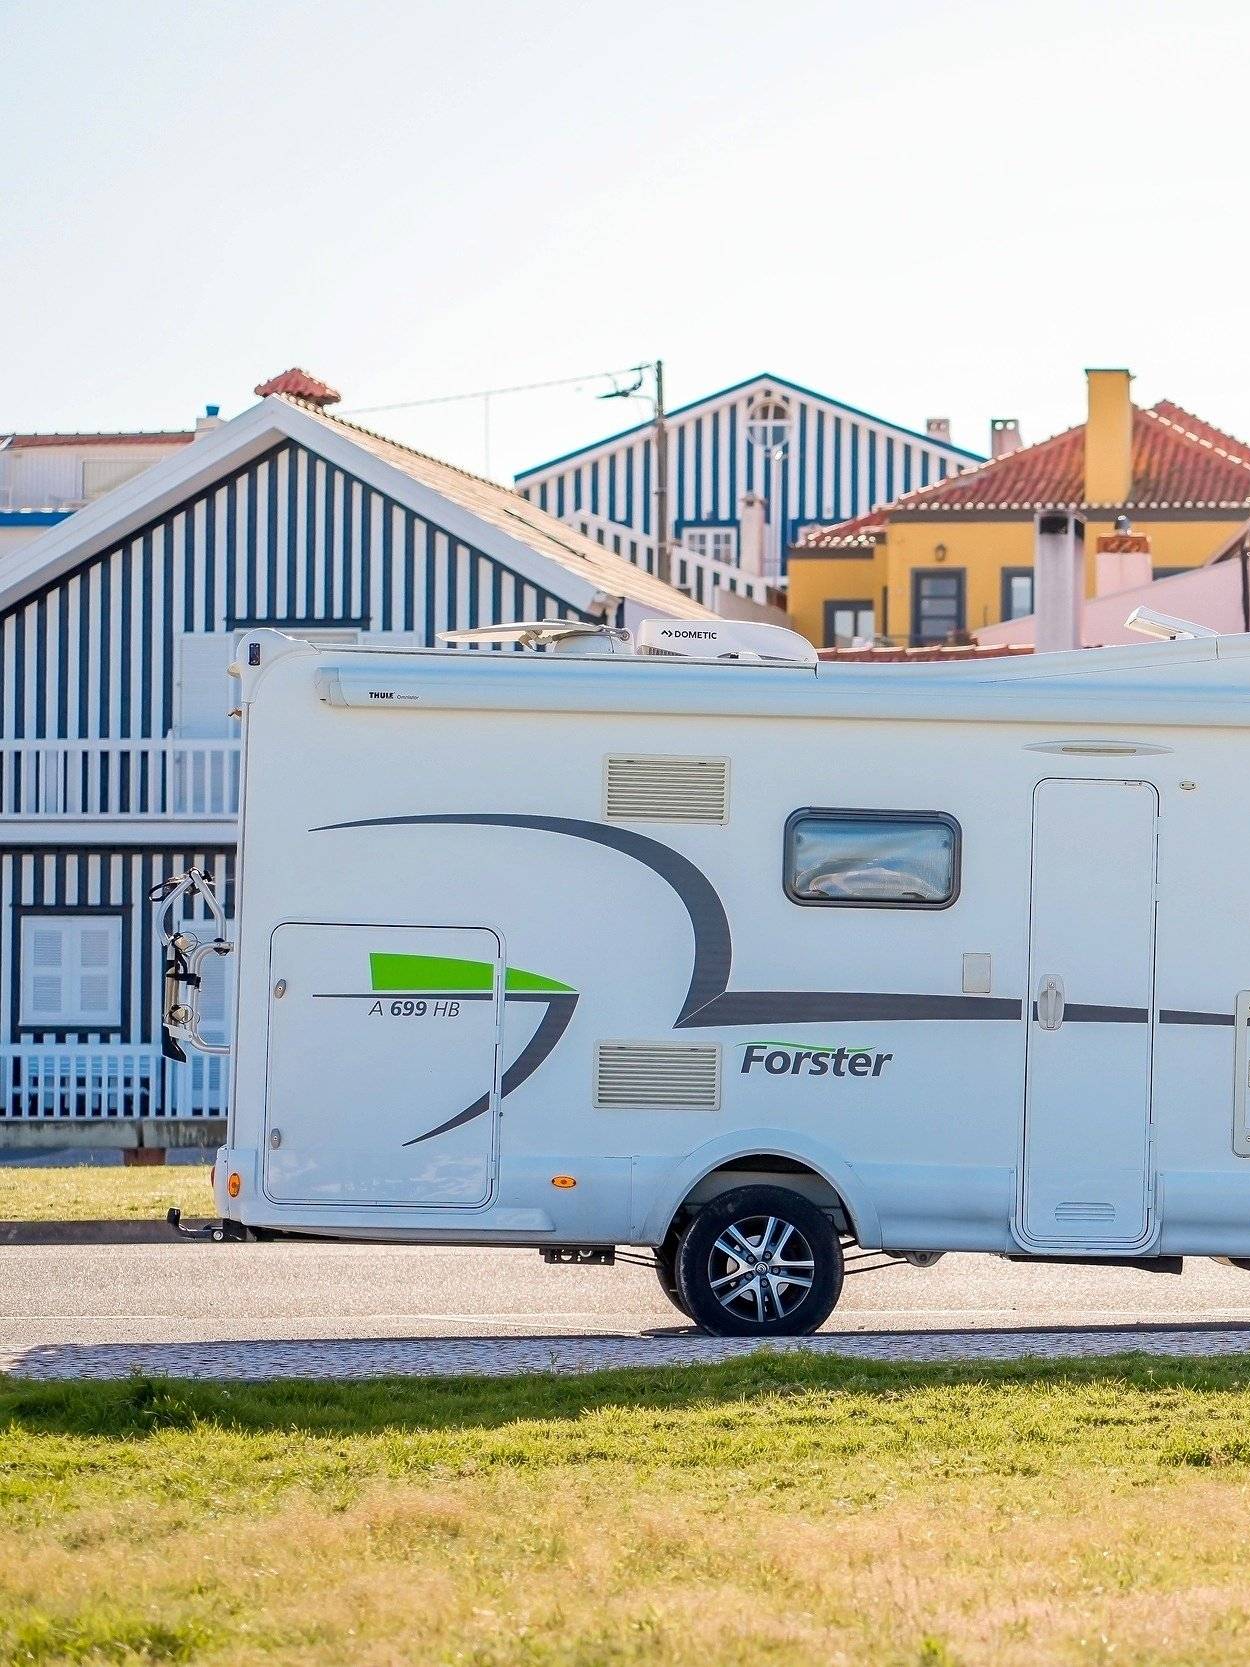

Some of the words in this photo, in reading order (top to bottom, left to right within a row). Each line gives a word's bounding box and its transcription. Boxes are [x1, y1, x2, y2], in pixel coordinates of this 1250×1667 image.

[674, 630, 717, 639] DOMETIC
[368, 691, 394, 699] THULE
[368, 1000, 383, 1016] A
[390, 1000, 427, 1017] 699
[433, 1001, 460, 1017] HB
[740, 1045, 893, 1077] Forster
